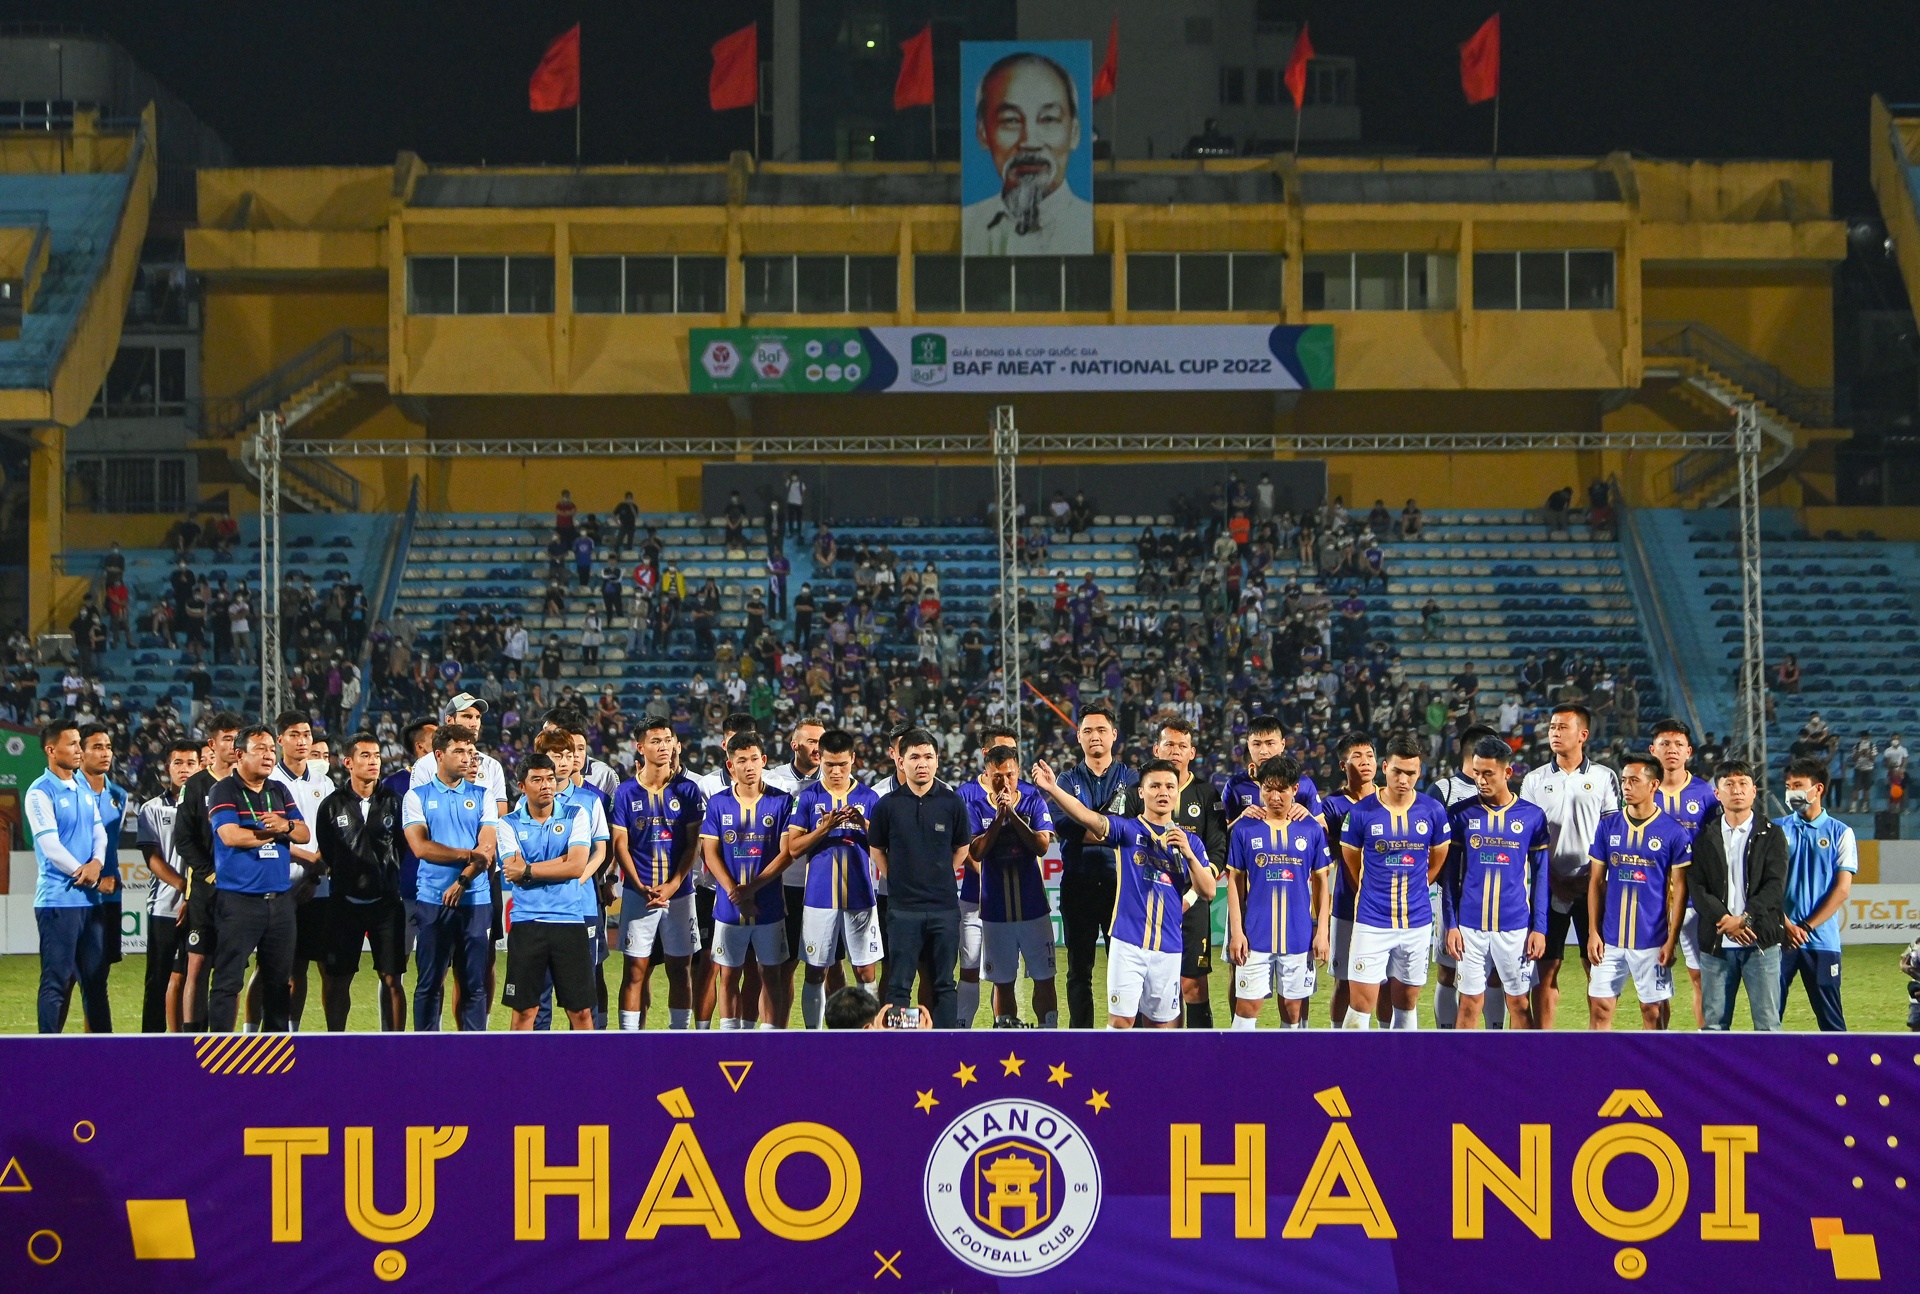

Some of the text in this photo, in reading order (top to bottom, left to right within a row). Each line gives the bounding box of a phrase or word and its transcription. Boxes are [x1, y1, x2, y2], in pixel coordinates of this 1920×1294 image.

[953, 359, 1272, 375] BAF MEAT NATIONAL CUP 2022
[870, 925, 876, 939] 9
[952, 1108, 1072, 1152] HANOI
[244, 1086, 1759, 1282] TỰ HÀO HÀ NỘI
[937, 1183, 1088, 1193] 20 06
[952, 1224, 1075, 1263] FOOTBALL CLUB
